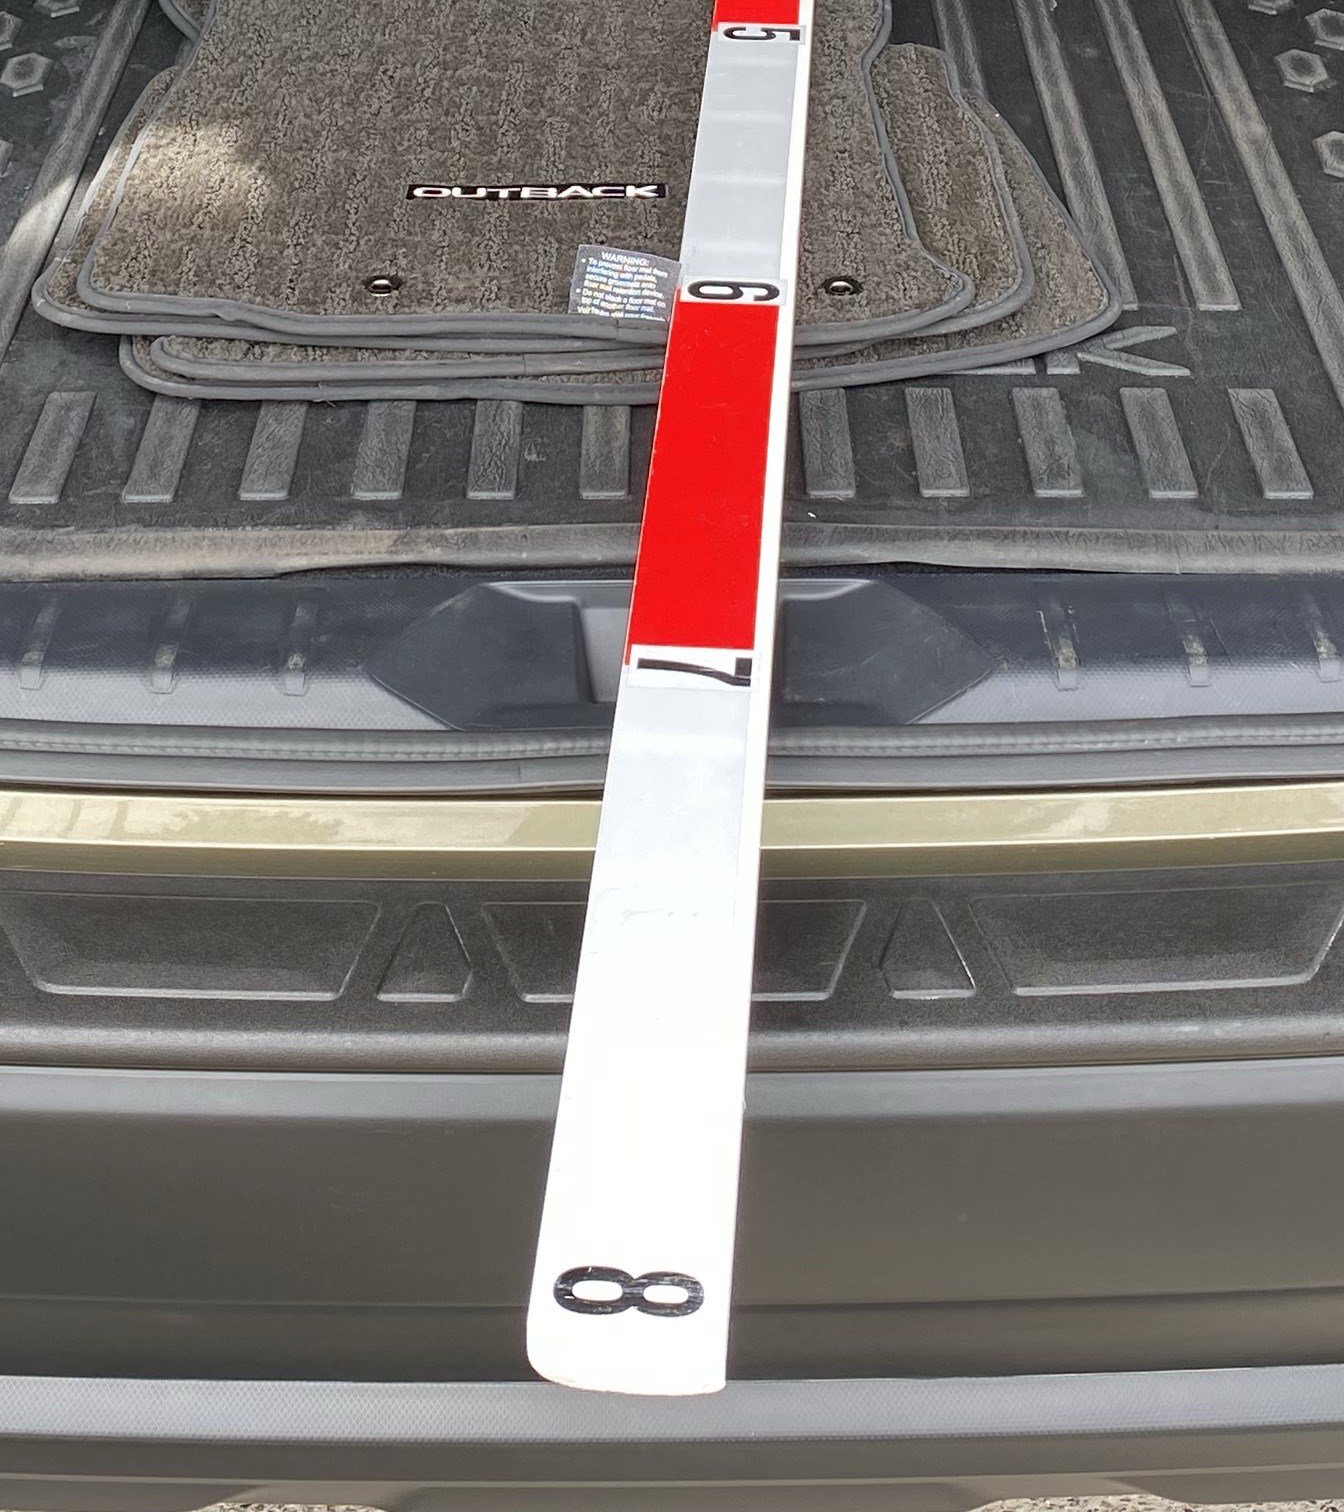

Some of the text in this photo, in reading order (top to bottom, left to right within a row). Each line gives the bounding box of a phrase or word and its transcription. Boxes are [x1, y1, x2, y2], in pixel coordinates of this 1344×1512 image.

[723, 27, 801, 41] 5
[413, 184, 659, 199] OUTBACK
[602, 252, 649, 266] WARNING:
[688, 281, 780, 301] 6
[637, 658, 752, 687] 7
[553, 1266, 704, 1317] 8
